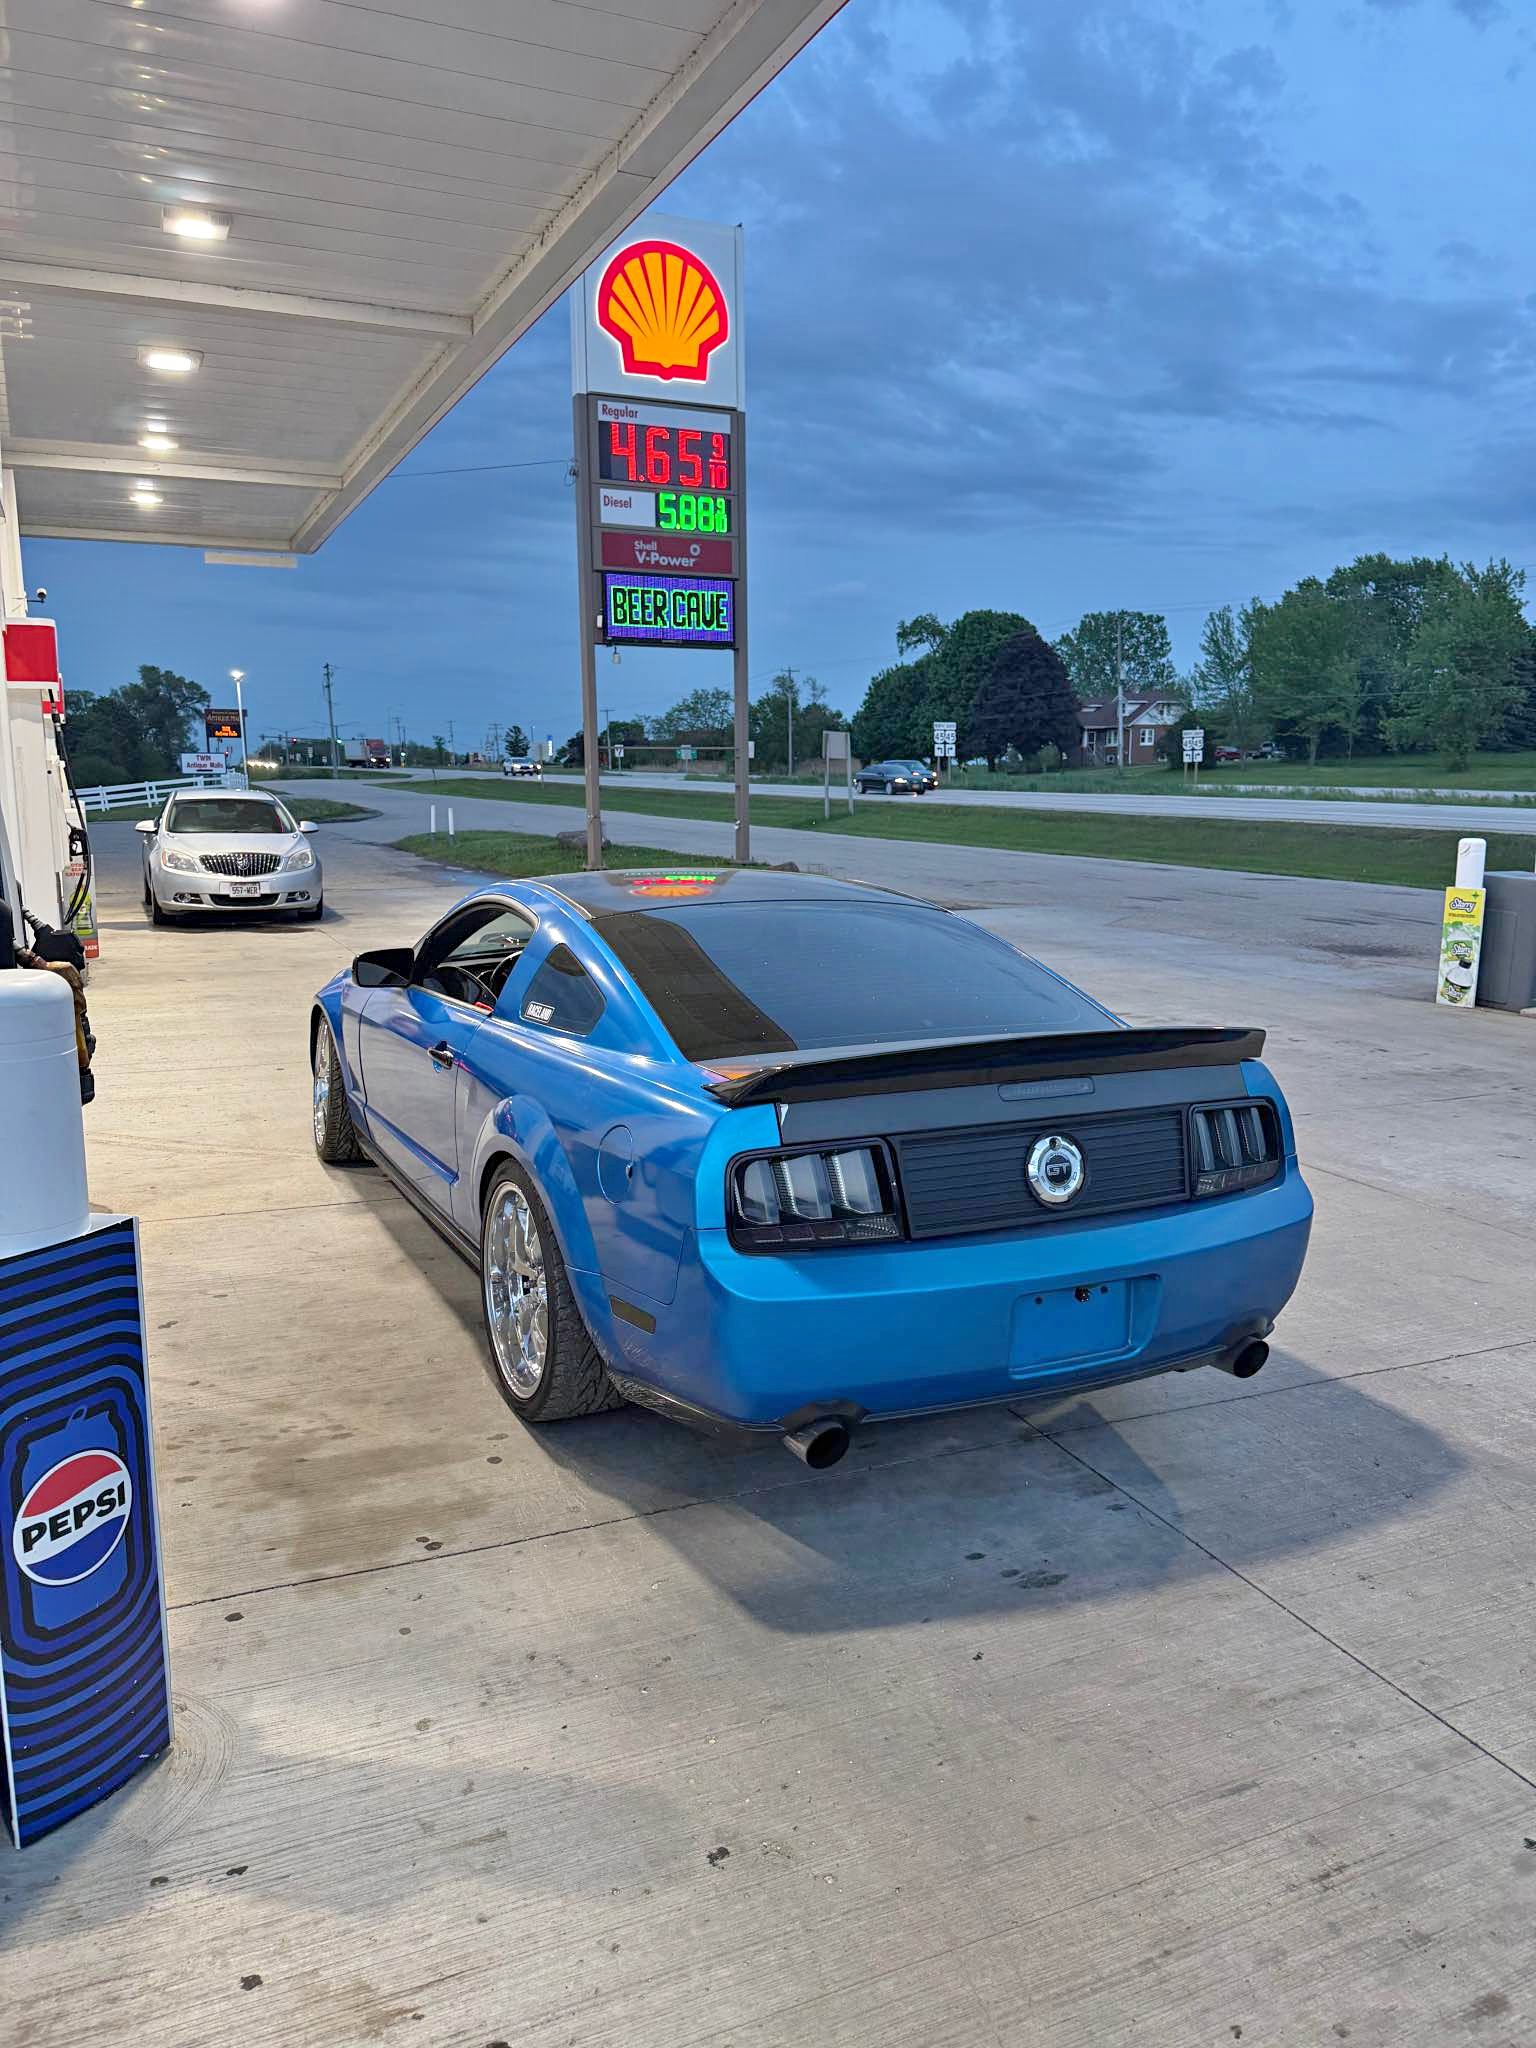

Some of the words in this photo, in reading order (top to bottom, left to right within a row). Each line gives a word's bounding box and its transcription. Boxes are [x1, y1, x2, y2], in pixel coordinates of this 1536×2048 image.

[602, 404, 639, 419] Regular
[603, 496, 632, 509] Diesel
[634, 540, 657, 551] Shell
[635, 551, 696, 567] V-Power
[611, 585, 669, 628] BEER
[671, 589, 729, 631] CAVE
[1449, 897, 1476, 913] Starry
[1047, 1162, 1070, 1176] GT
[22, 1480, 125, 1554] PEPSI
